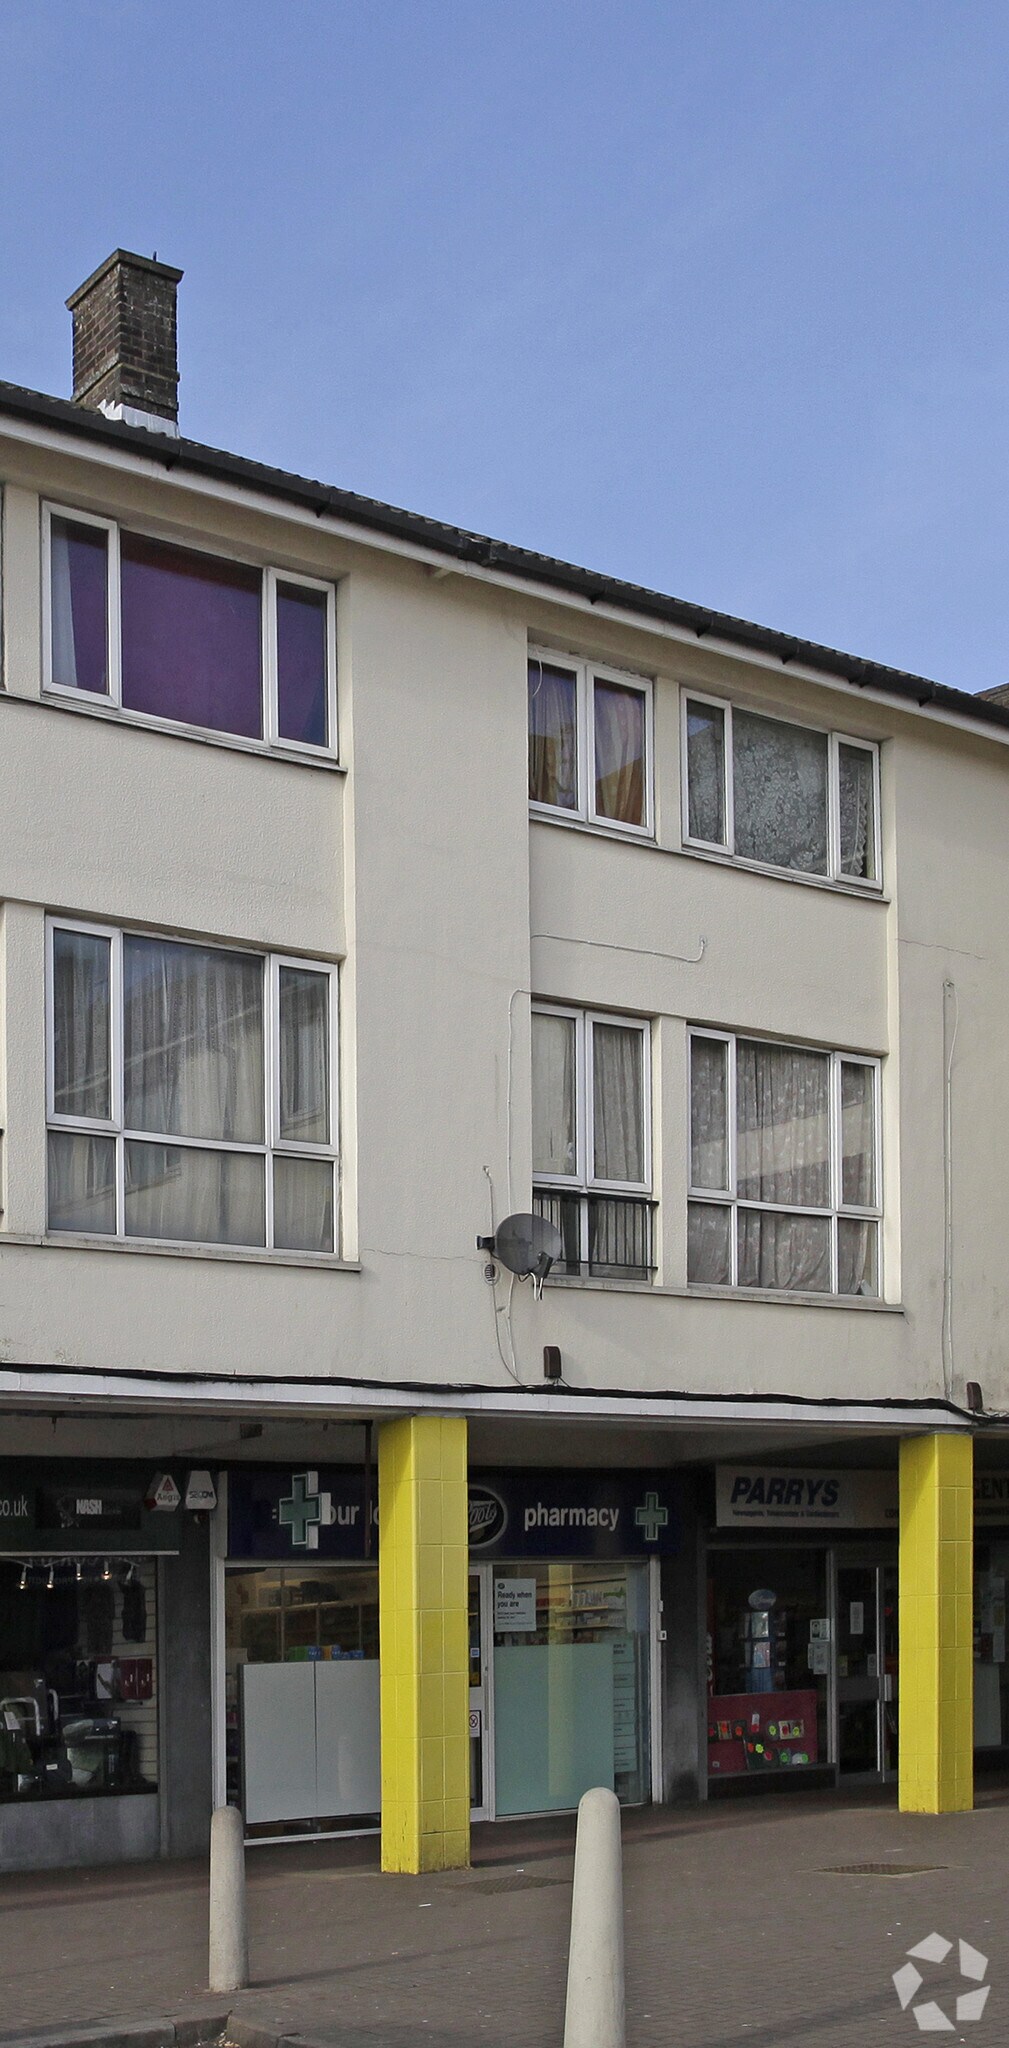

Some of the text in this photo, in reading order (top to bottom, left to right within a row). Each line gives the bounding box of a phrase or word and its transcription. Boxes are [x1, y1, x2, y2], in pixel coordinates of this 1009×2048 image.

[731, 1476, 840, 1506] PARRYS
[76, 1498, 102, 1515] NASH
[468, 1500, 498, 1530] oots
[524, 1501, 620, 1532] pharmacy
[497, 1591, 515, 1600] Ready
[497, 1601, 508, 1609] you
